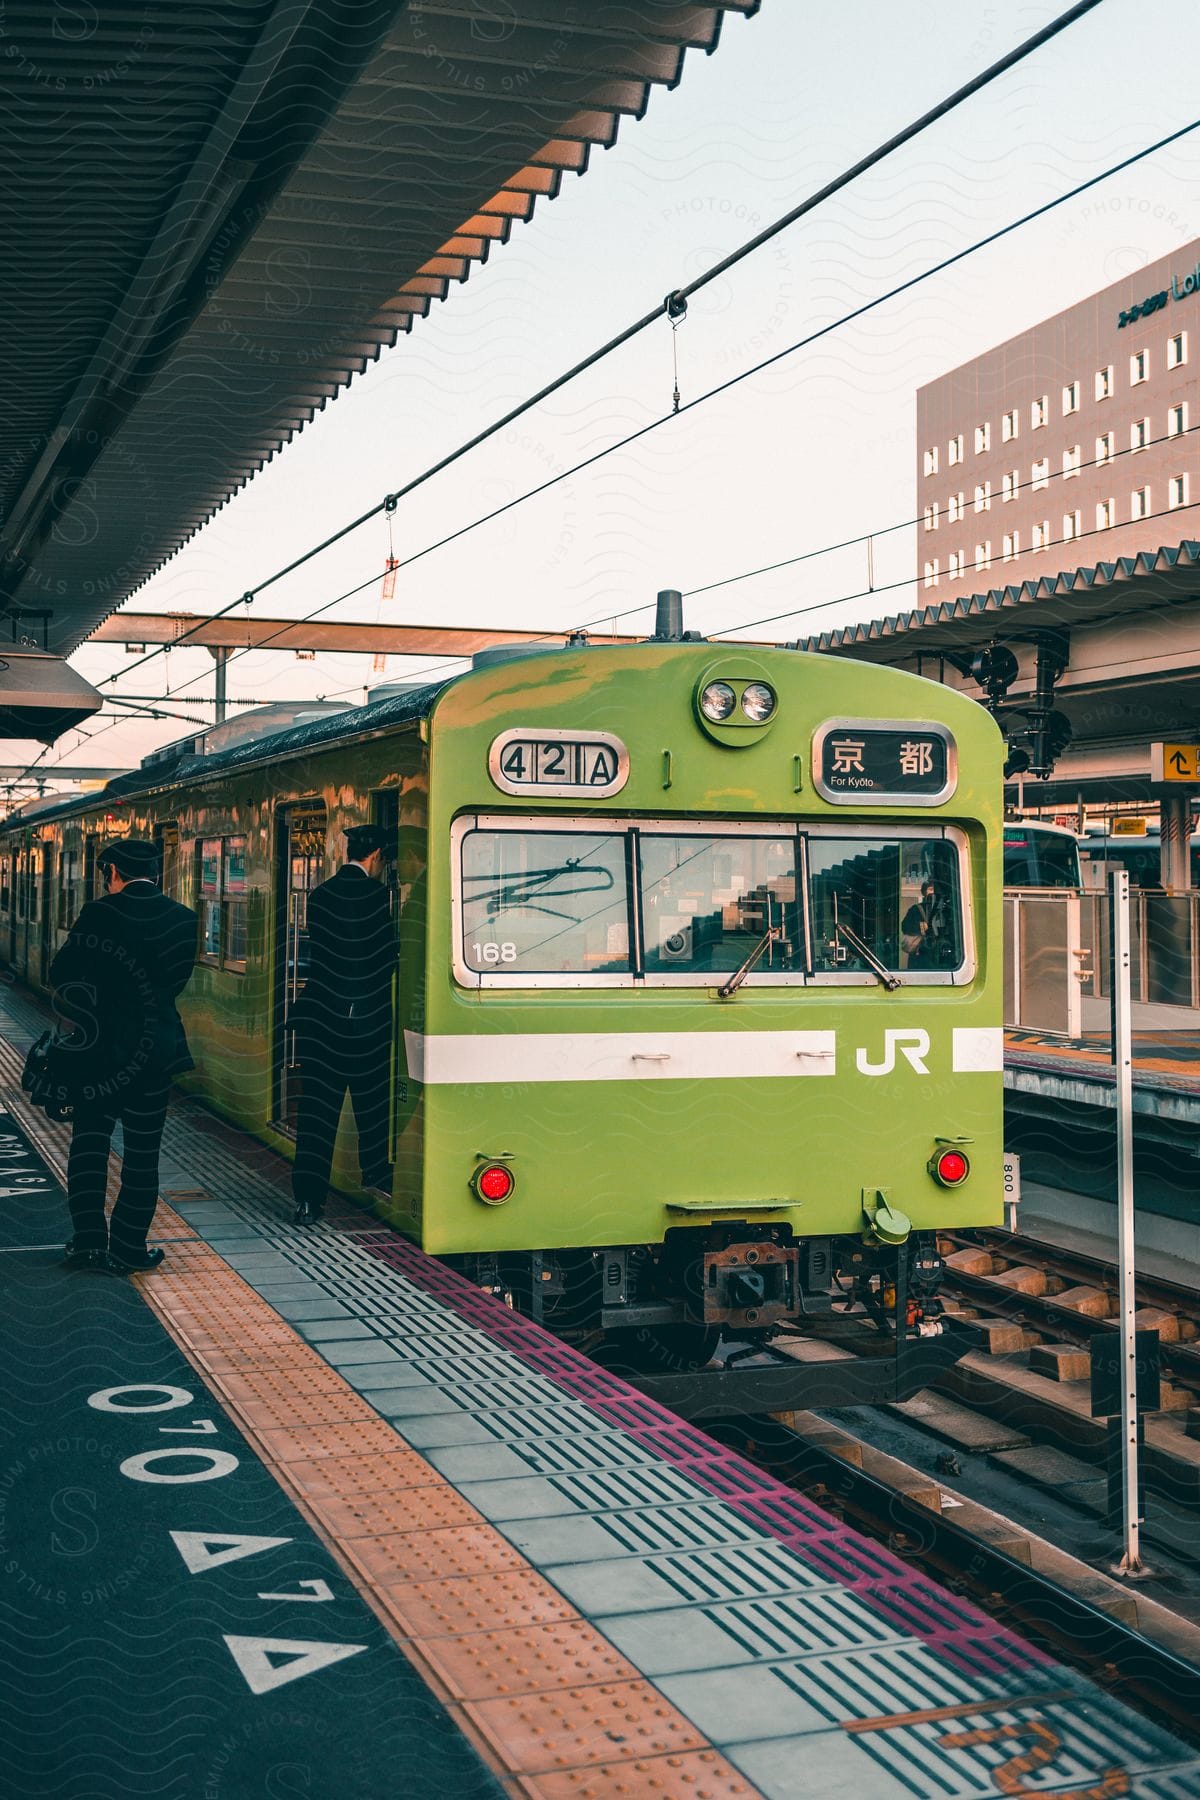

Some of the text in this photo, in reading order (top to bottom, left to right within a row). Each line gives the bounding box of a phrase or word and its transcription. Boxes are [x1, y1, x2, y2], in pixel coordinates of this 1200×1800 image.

[831, 738, 934, 776] 京都
[830, 776, 846, 787] For
[472, 942, 518, 963] 168
[856, 1028, 931, 1076] JR
[1004, 1164, 1014, 1192] 800
